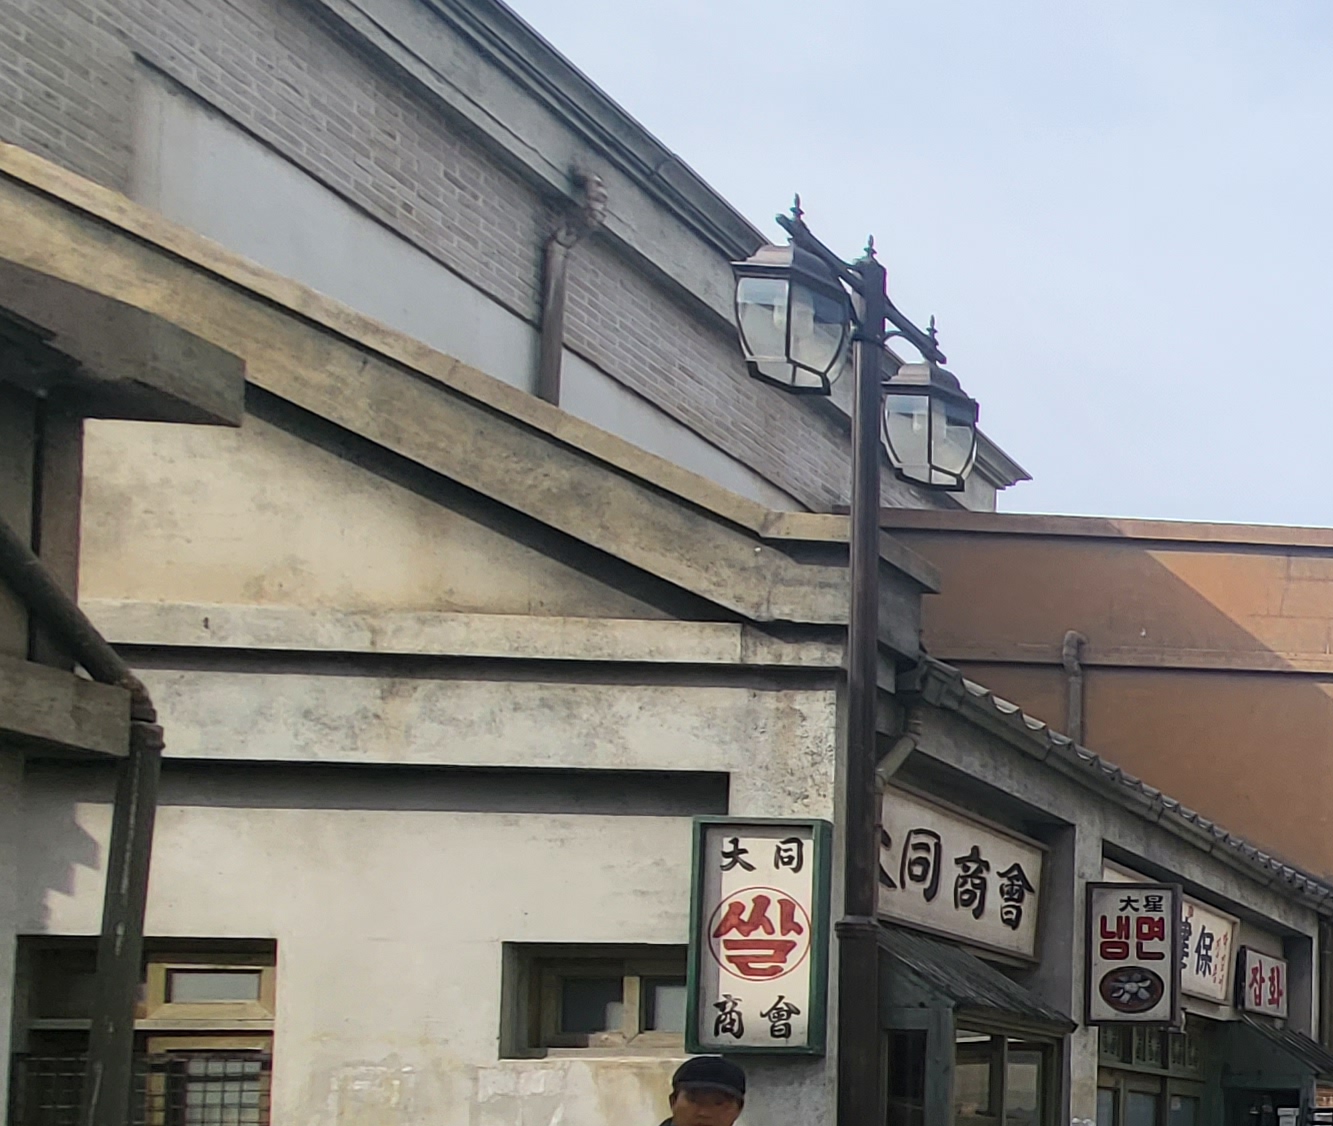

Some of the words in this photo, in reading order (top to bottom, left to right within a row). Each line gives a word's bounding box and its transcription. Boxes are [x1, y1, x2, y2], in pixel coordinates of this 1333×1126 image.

[720, 837, 804, 874] 大同
[1118, 895, 1164, 912] 大星
[713, 895, 804, 977] 쌀
[1100, 915, 1165, 961] 냉면
[1248, 959, 1284, 1009] 잡화
[713, 994, 801, 1039] 商會
